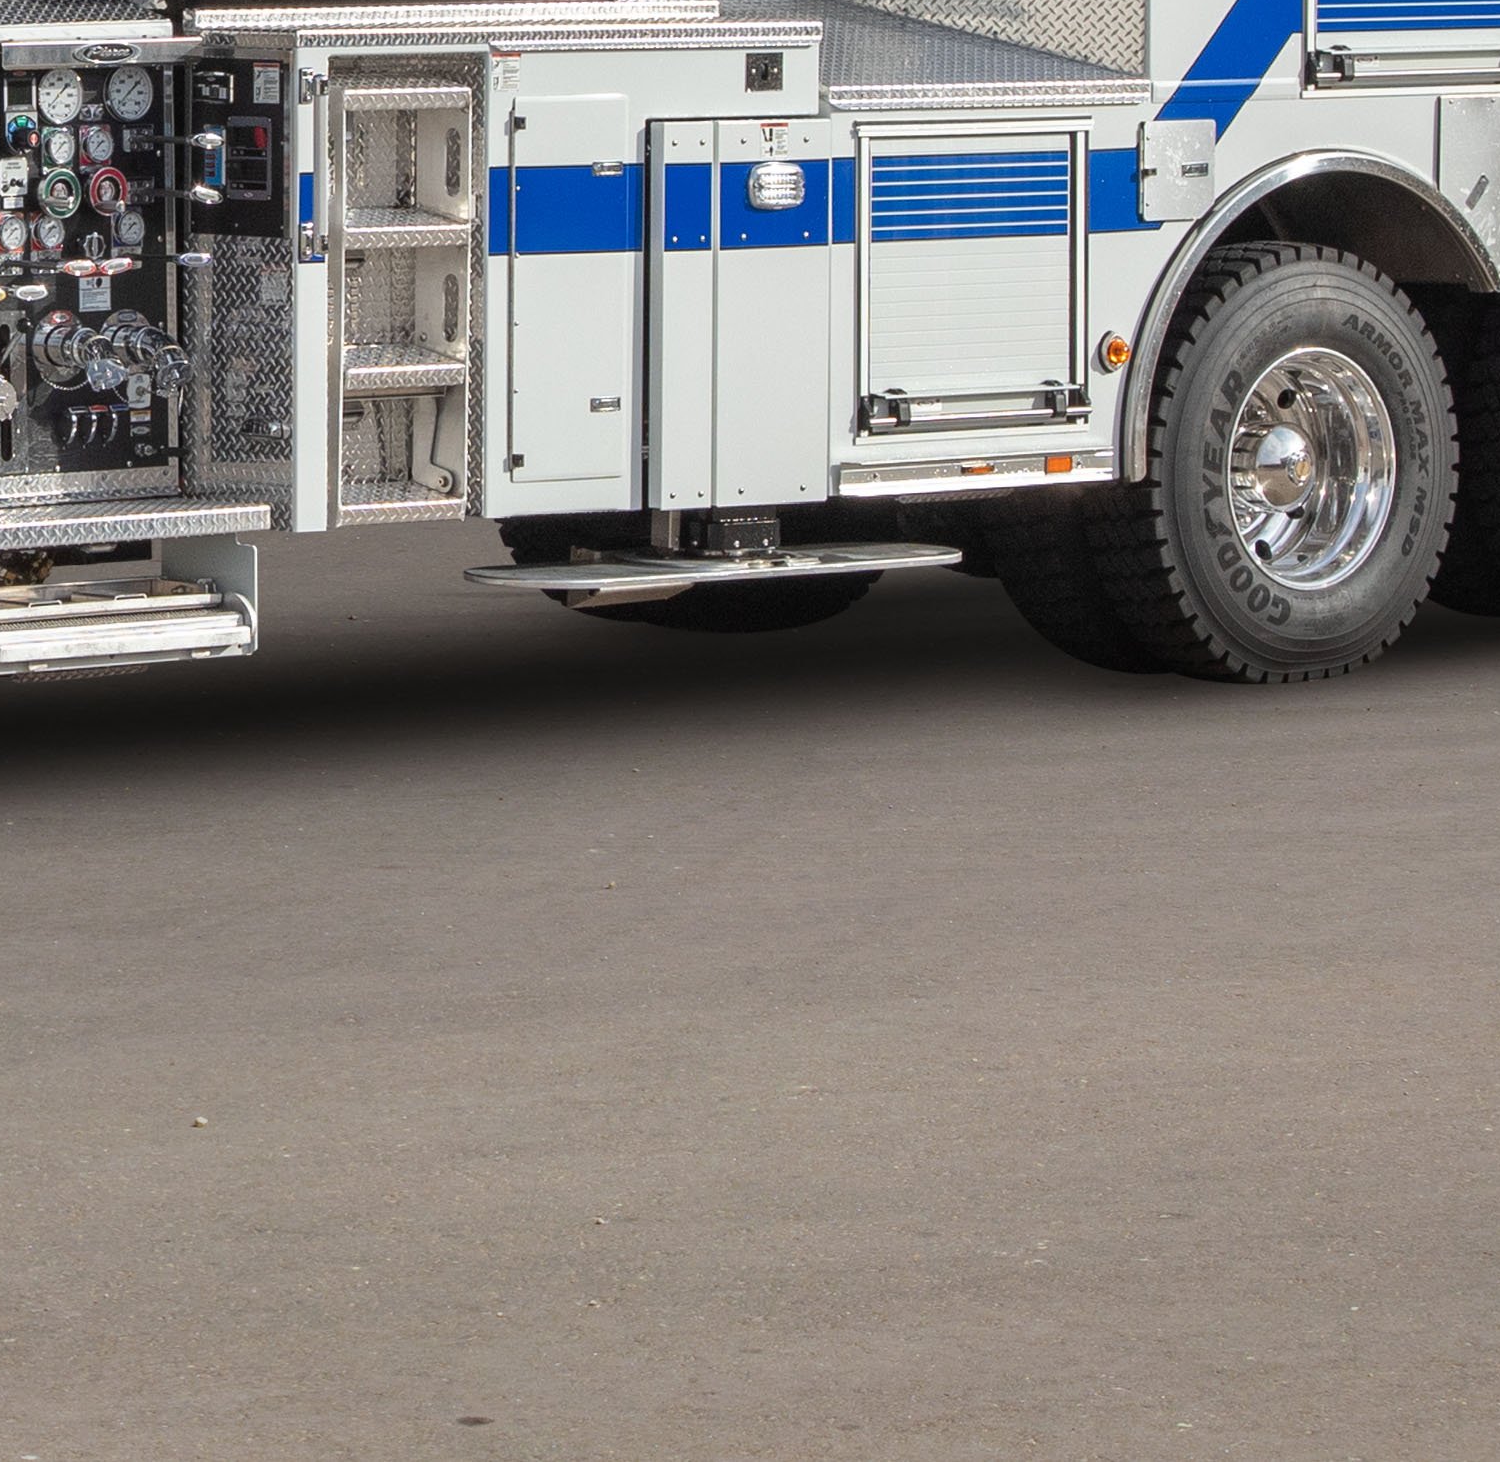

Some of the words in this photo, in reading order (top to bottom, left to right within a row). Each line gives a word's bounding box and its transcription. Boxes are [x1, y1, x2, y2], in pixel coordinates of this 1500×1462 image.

[1342, 314, 1413, 389] ARMOR
[1409, 398, 1430, 479] MAX
[1202, 370, 1292, 626] GOODYEAR
[1401, 487, 1428, 557] MSD
